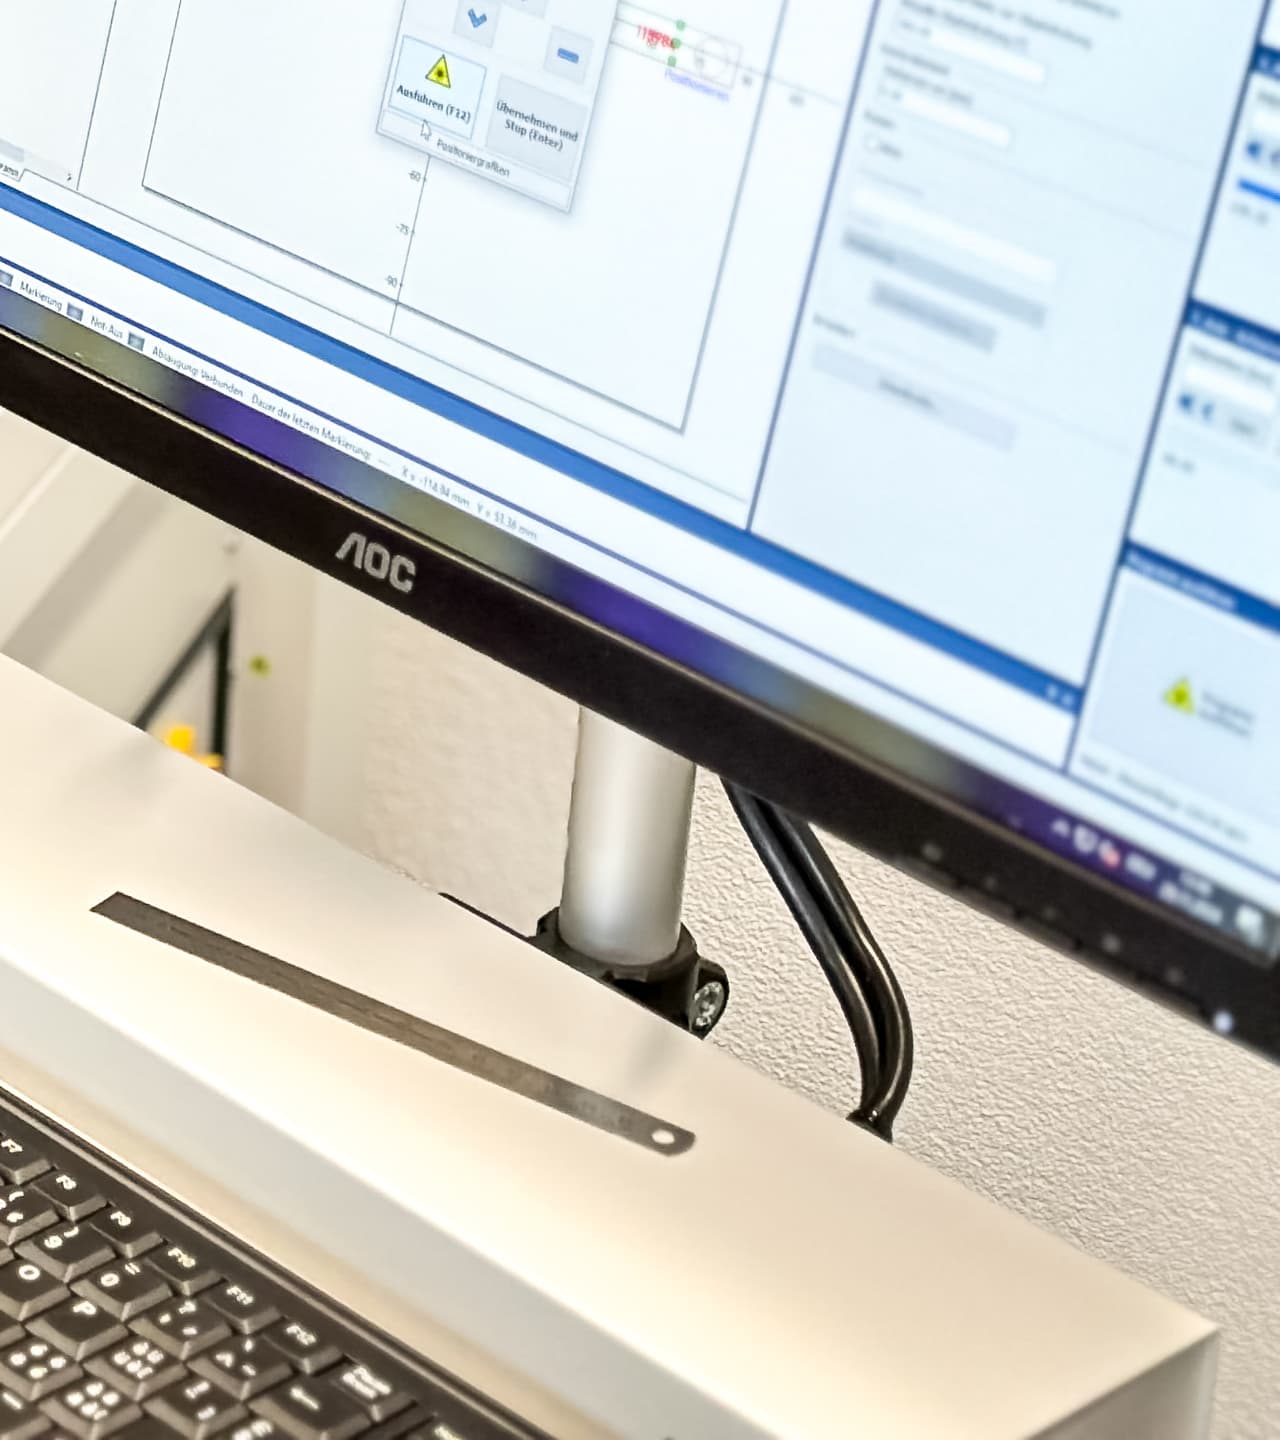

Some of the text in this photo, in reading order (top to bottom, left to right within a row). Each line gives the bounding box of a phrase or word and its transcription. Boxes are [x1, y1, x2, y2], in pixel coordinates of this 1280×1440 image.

[445, 104, 471, 124] (F12)
[559, 128, 578, 142] und
[335, 532, 416, 593] AOC
